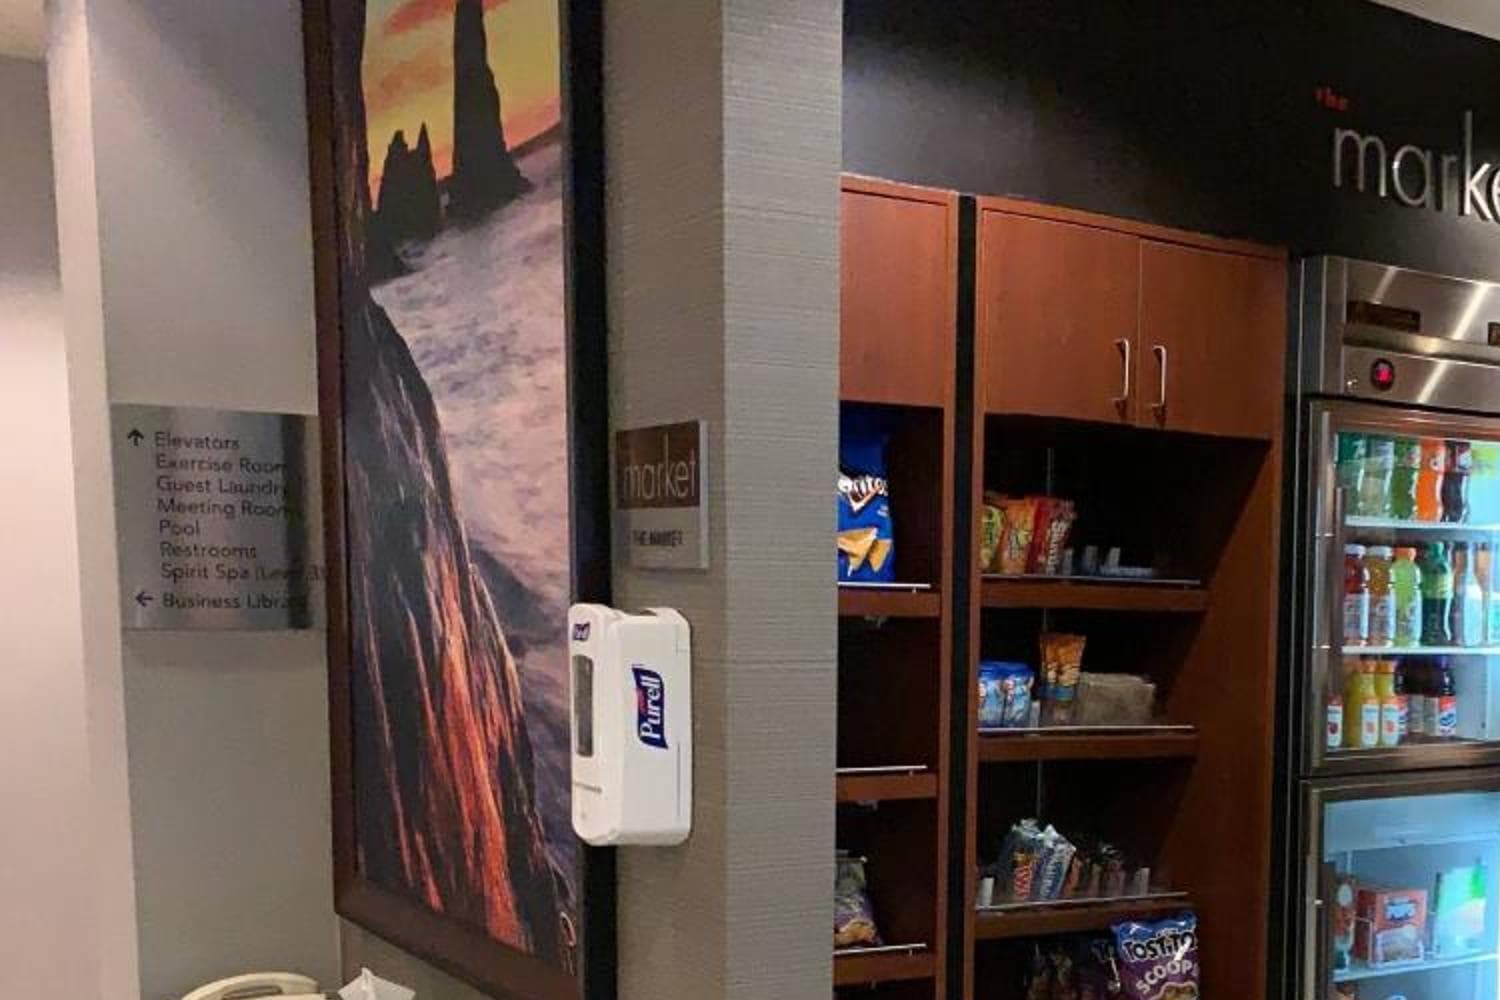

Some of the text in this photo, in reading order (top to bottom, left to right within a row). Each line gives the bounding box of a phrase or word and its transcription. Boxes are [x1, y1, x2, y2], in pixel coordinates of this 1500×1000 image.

[155, 431, 240, 450] Elevators
[155, 453, 233, 472] Exercise
[623, 432, 697, 500] market
[156, 475, 212, 493] Guest
[157, 498, 236, 520] Meeting
[159, 519, 200, 537] Pool
[160, 541, 257, 559] Restrooms
[161, 563, 209, 584] Spirit
[215, 565, 249, 582] Spa
[162, 593, 240, 610] Business
[1123, 932, 1198, 960] TOSTITO
